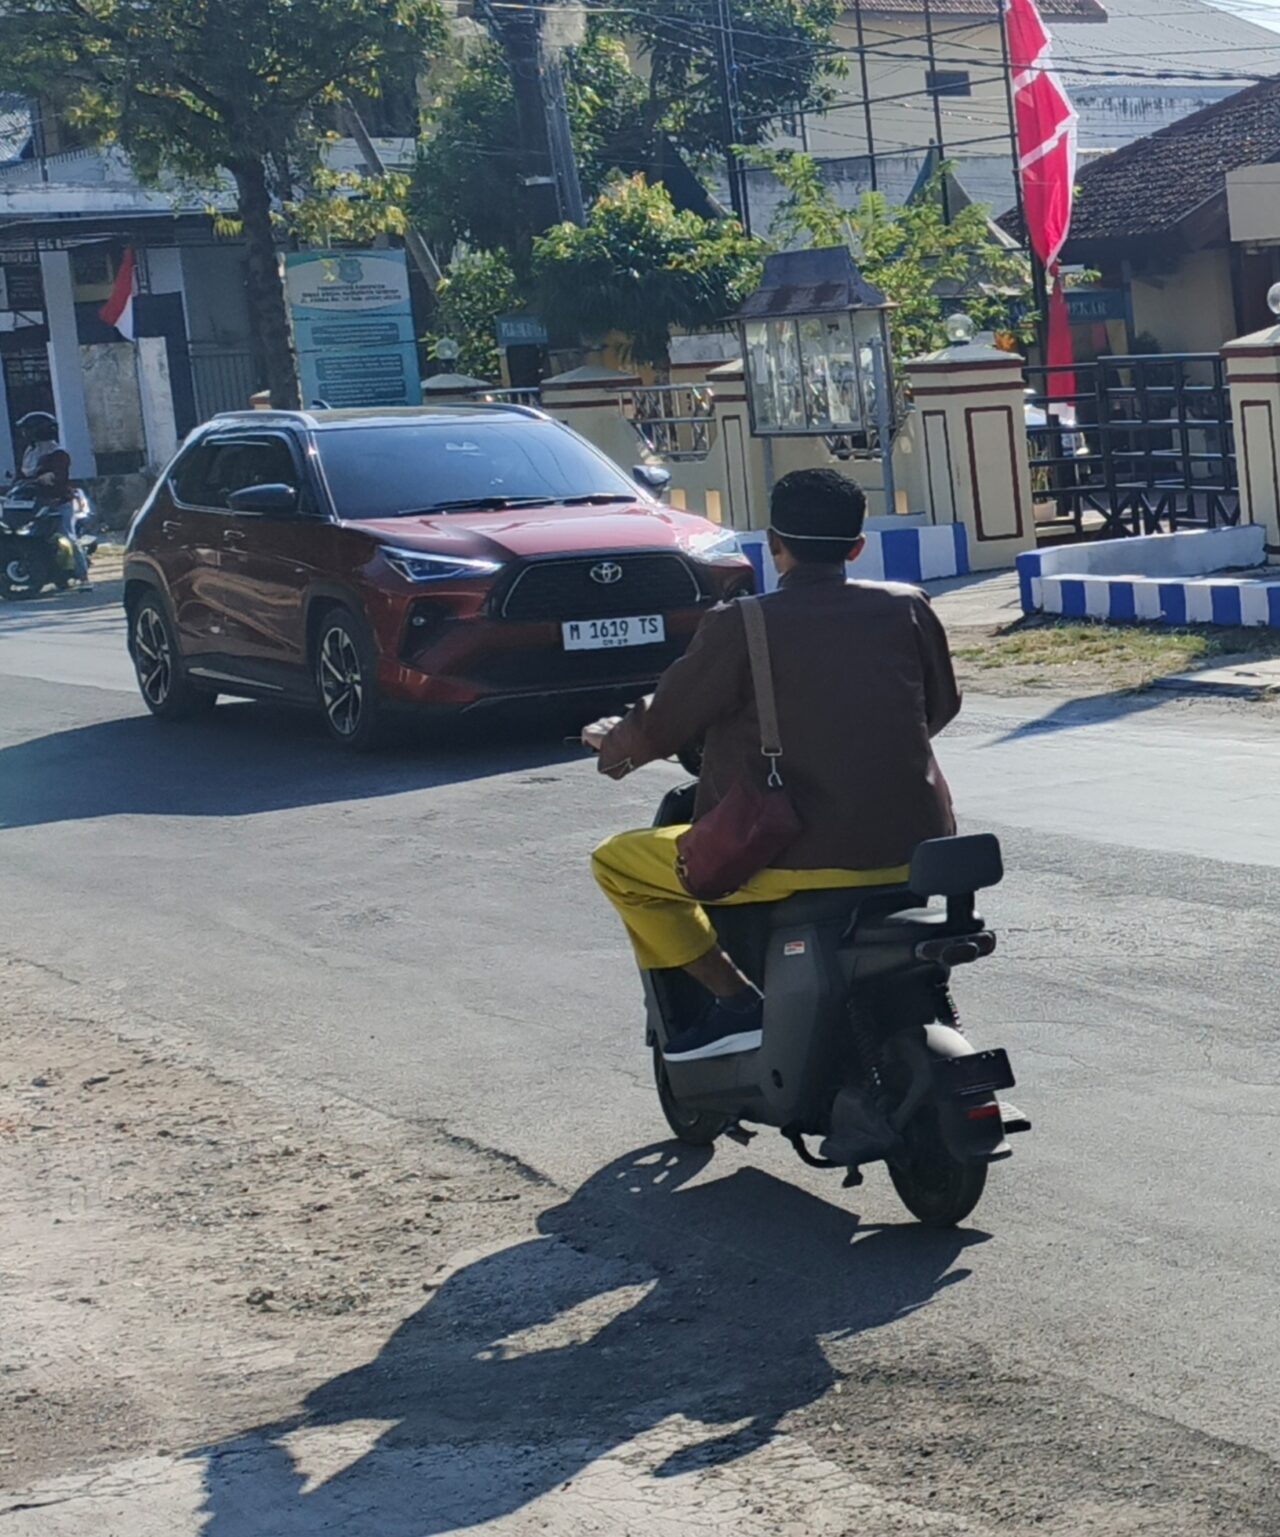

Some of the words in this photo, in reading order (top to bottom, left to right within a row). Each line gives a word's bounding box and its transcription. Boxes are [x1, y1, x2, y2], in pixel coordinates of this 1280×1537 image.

[570, 625, 580, 640] M
[590, 621, 629, 639] 1619
[639, 618, 658, 634] TS
